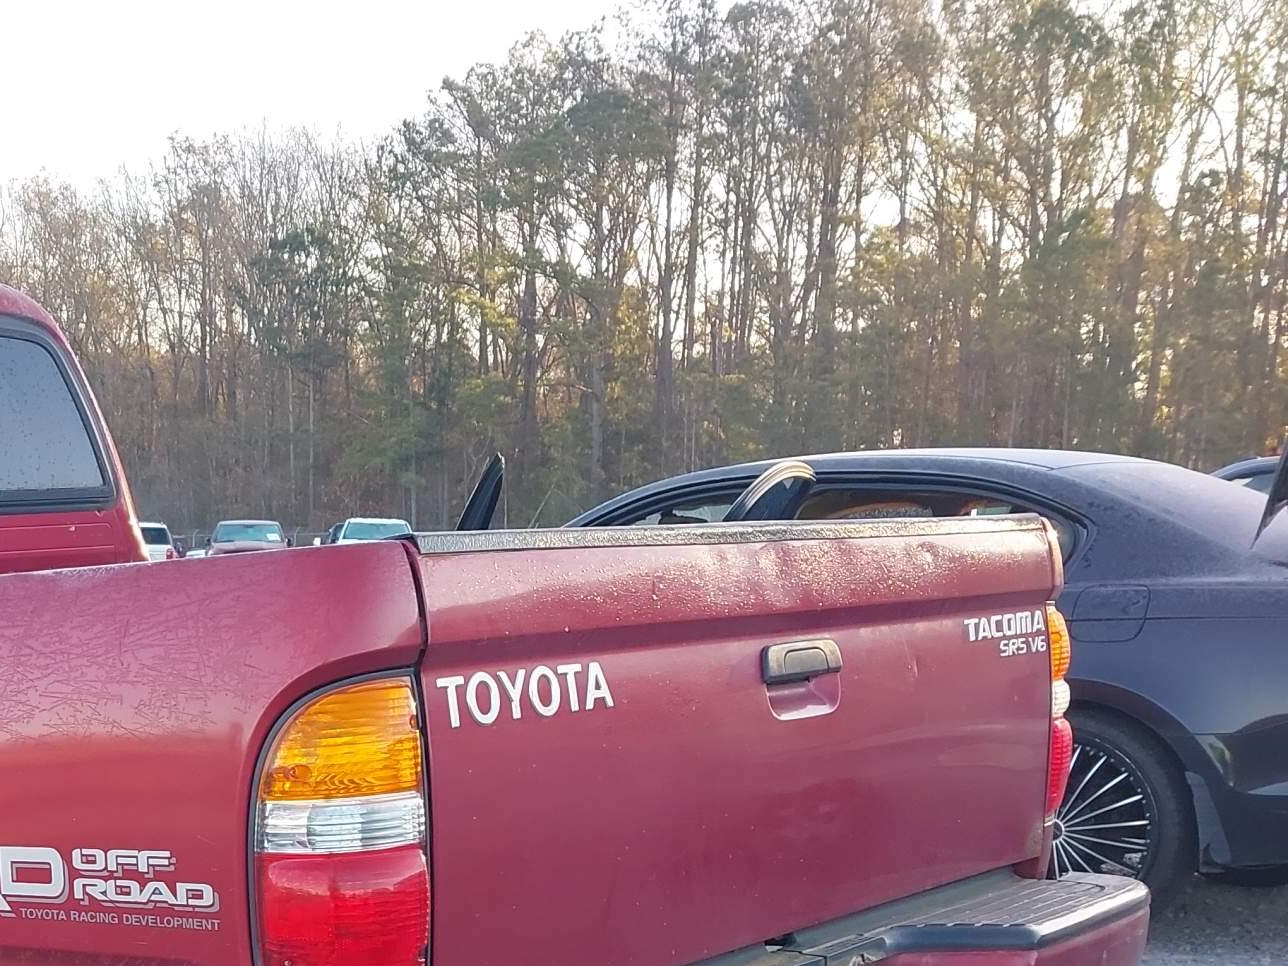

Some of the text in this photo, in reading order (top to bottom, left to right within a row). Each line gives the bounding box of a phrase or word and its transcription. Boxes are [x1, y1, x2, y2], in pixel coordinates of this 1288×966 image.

[963, 610, 1045, 642] TACOMA
[999, 635, 1047, 657] SR5 V6
[435, 661, 615, 729] TOYOTA
[71, 847, 177, 878] OFF
[73, 877, 220, 912] ROAD
[19, 907, 221, 932] TOYOTA RACING DEVELOPMENT
